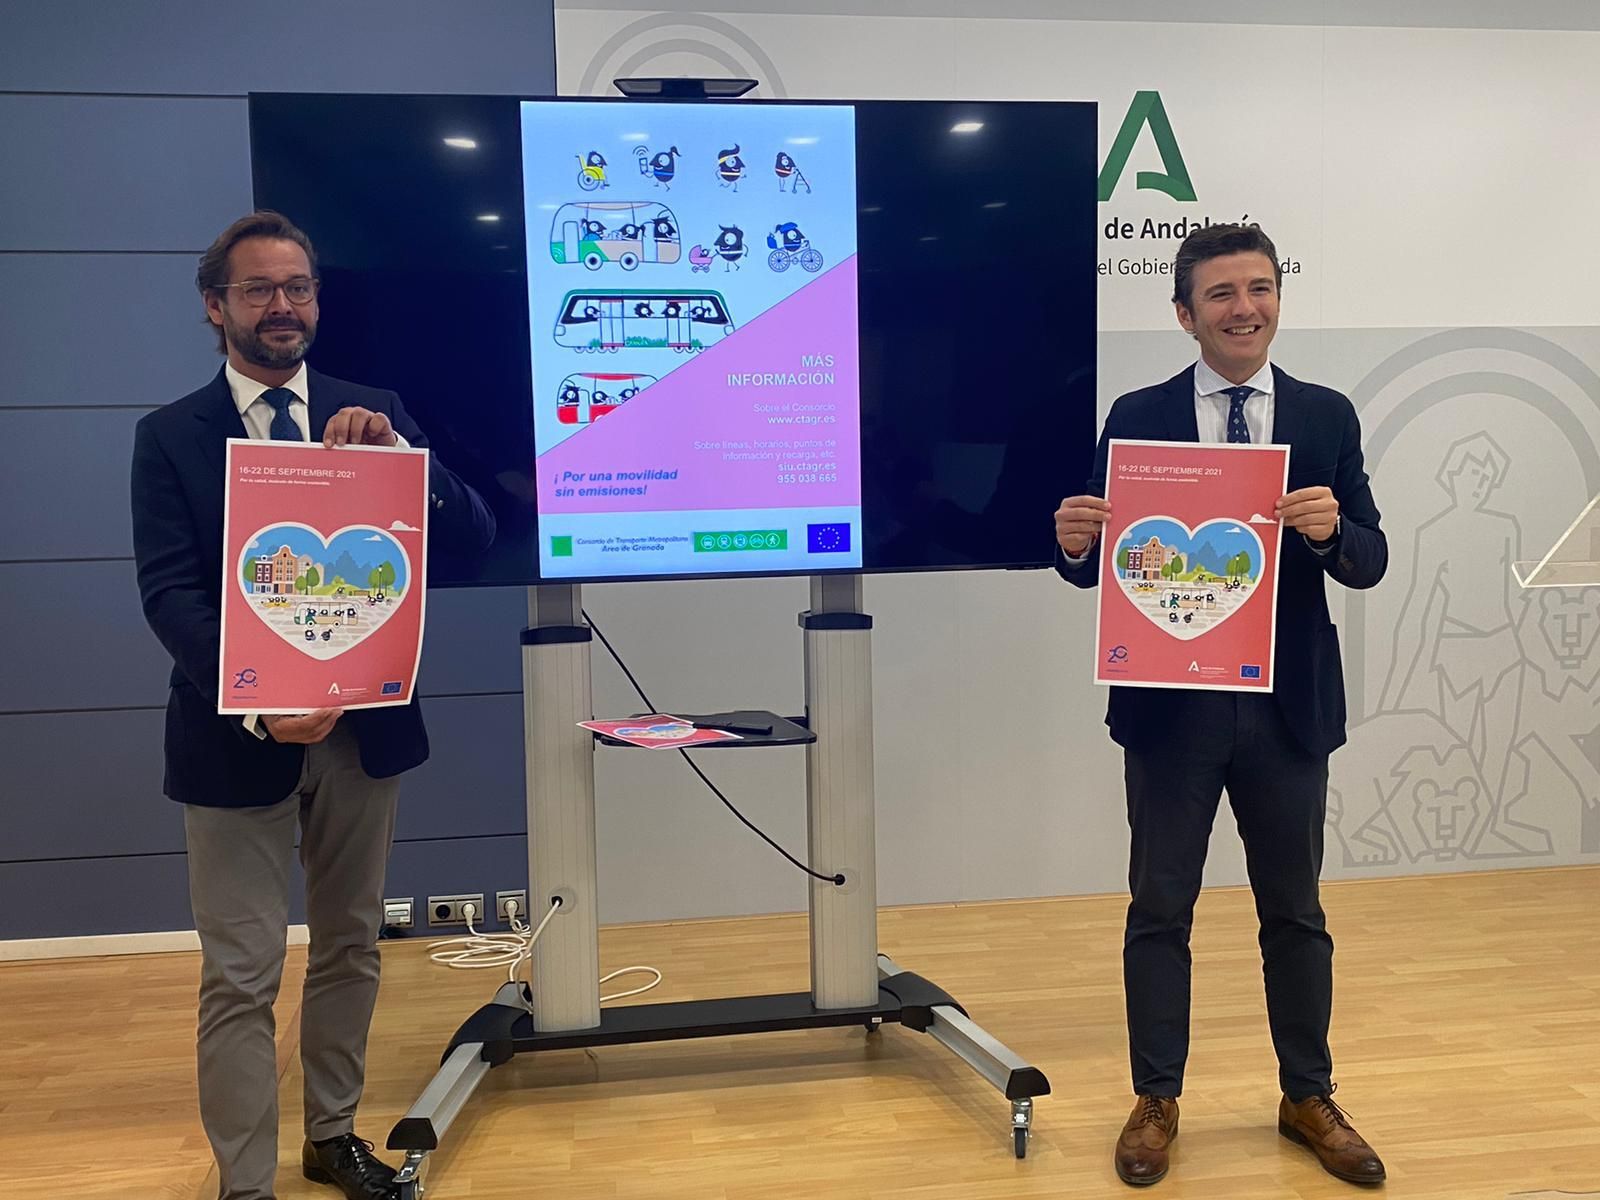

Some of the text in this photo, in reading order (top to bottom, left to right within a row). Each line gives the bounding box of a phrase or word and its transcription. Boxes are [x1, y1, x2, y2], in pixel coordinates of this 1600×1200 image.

[1104, 217, 1134, 240] de
[1118, 258, 1176, 275] Gobier
[801, 352, 834, 367] MÁS
[727, 370, 835, 386] INFORMACIÓN
[753, 402, 836, 413] Sobre el Consorcio
[767, 415, 836, 425] www.ctagr.es
[694, 441, 720, 450] Sobre
[794, 440, 823, 450] puntos
[824, 439, 836, 448] de
[239, 466, 356, 479] 16-22 DE SEPTIEMBRE 2021
[777, 462, 836, 472] siu.ctagr.es
[1118, 465, 1222, 476] 16-22 DE SEPTIEMBRE 2021
[563, 471, 585, 482] Por
[589, 472, 612, 481] una
[616, 469, 678, 480] movilidad
[777, 473, 837, 483] 955 038 665
[555, 485, 648, 497] sin emisiones!
